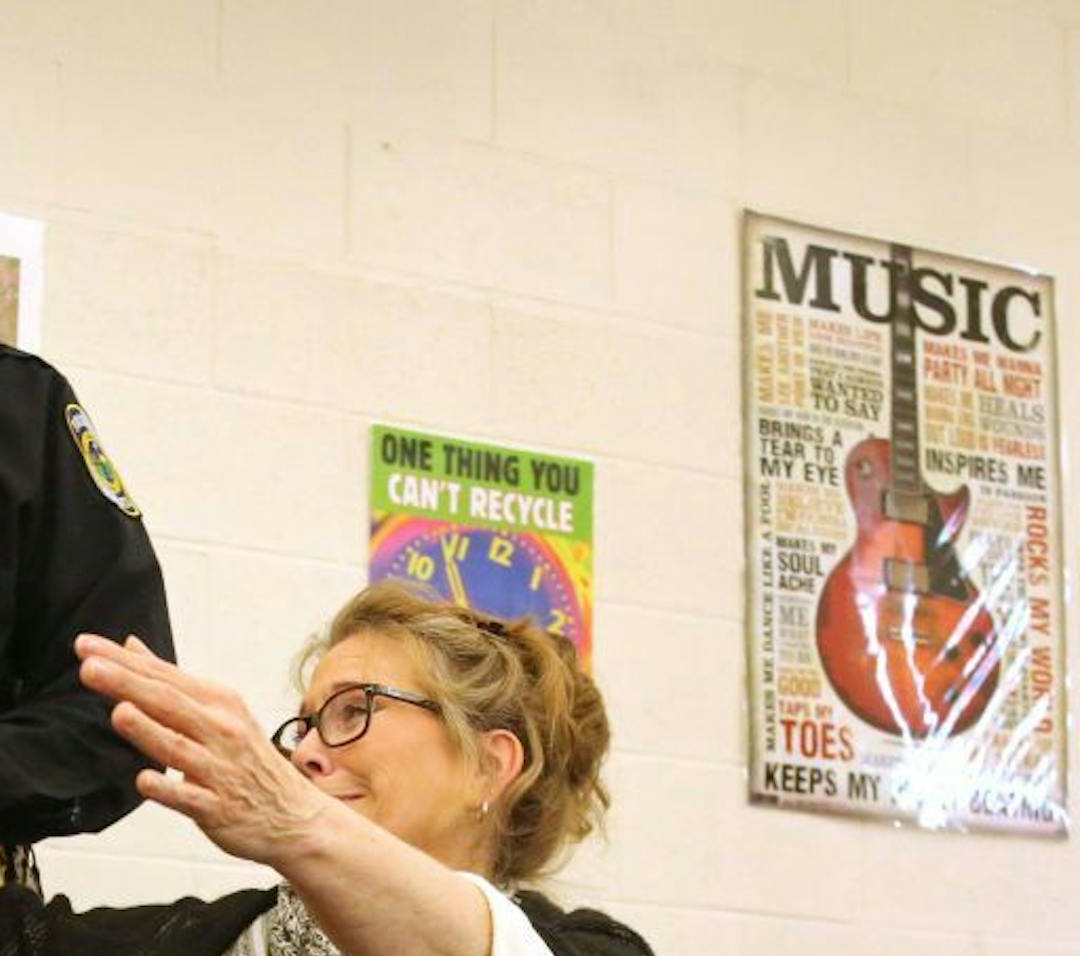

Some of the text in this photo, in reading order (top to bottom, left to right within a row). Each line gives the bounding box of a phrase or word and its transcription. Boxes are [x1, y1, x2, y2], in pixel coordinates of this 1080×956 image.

[755, 235, 1042, 353] MUSIC
[759, 418, 824, 444] BRINGS
[831, 429, 843, 449] A
[760, 437, 836, 465] TEAR TO
[381, 433, 581, 496] ONE THING YOU
[760, 456, 840, 487] MY EYE
[925, 446, 1047, 491] INSPIRES ME
[387, 473, 575, 533] CAN'T RECYCLE
[488, 535, 516, 568] 12
[777, 550, 825, 577] SOUL
[1025, 504, 1050, 587] ROCKS
[407, 550, 436, 581] 10
[529, 565, 543, 592] 1
[1029, 597, 1051, 636] MY
[780, 719, 855, 763] TOES
[764, 762, 838, 797] KEEPS
[847, 771, 881, 804] MY
